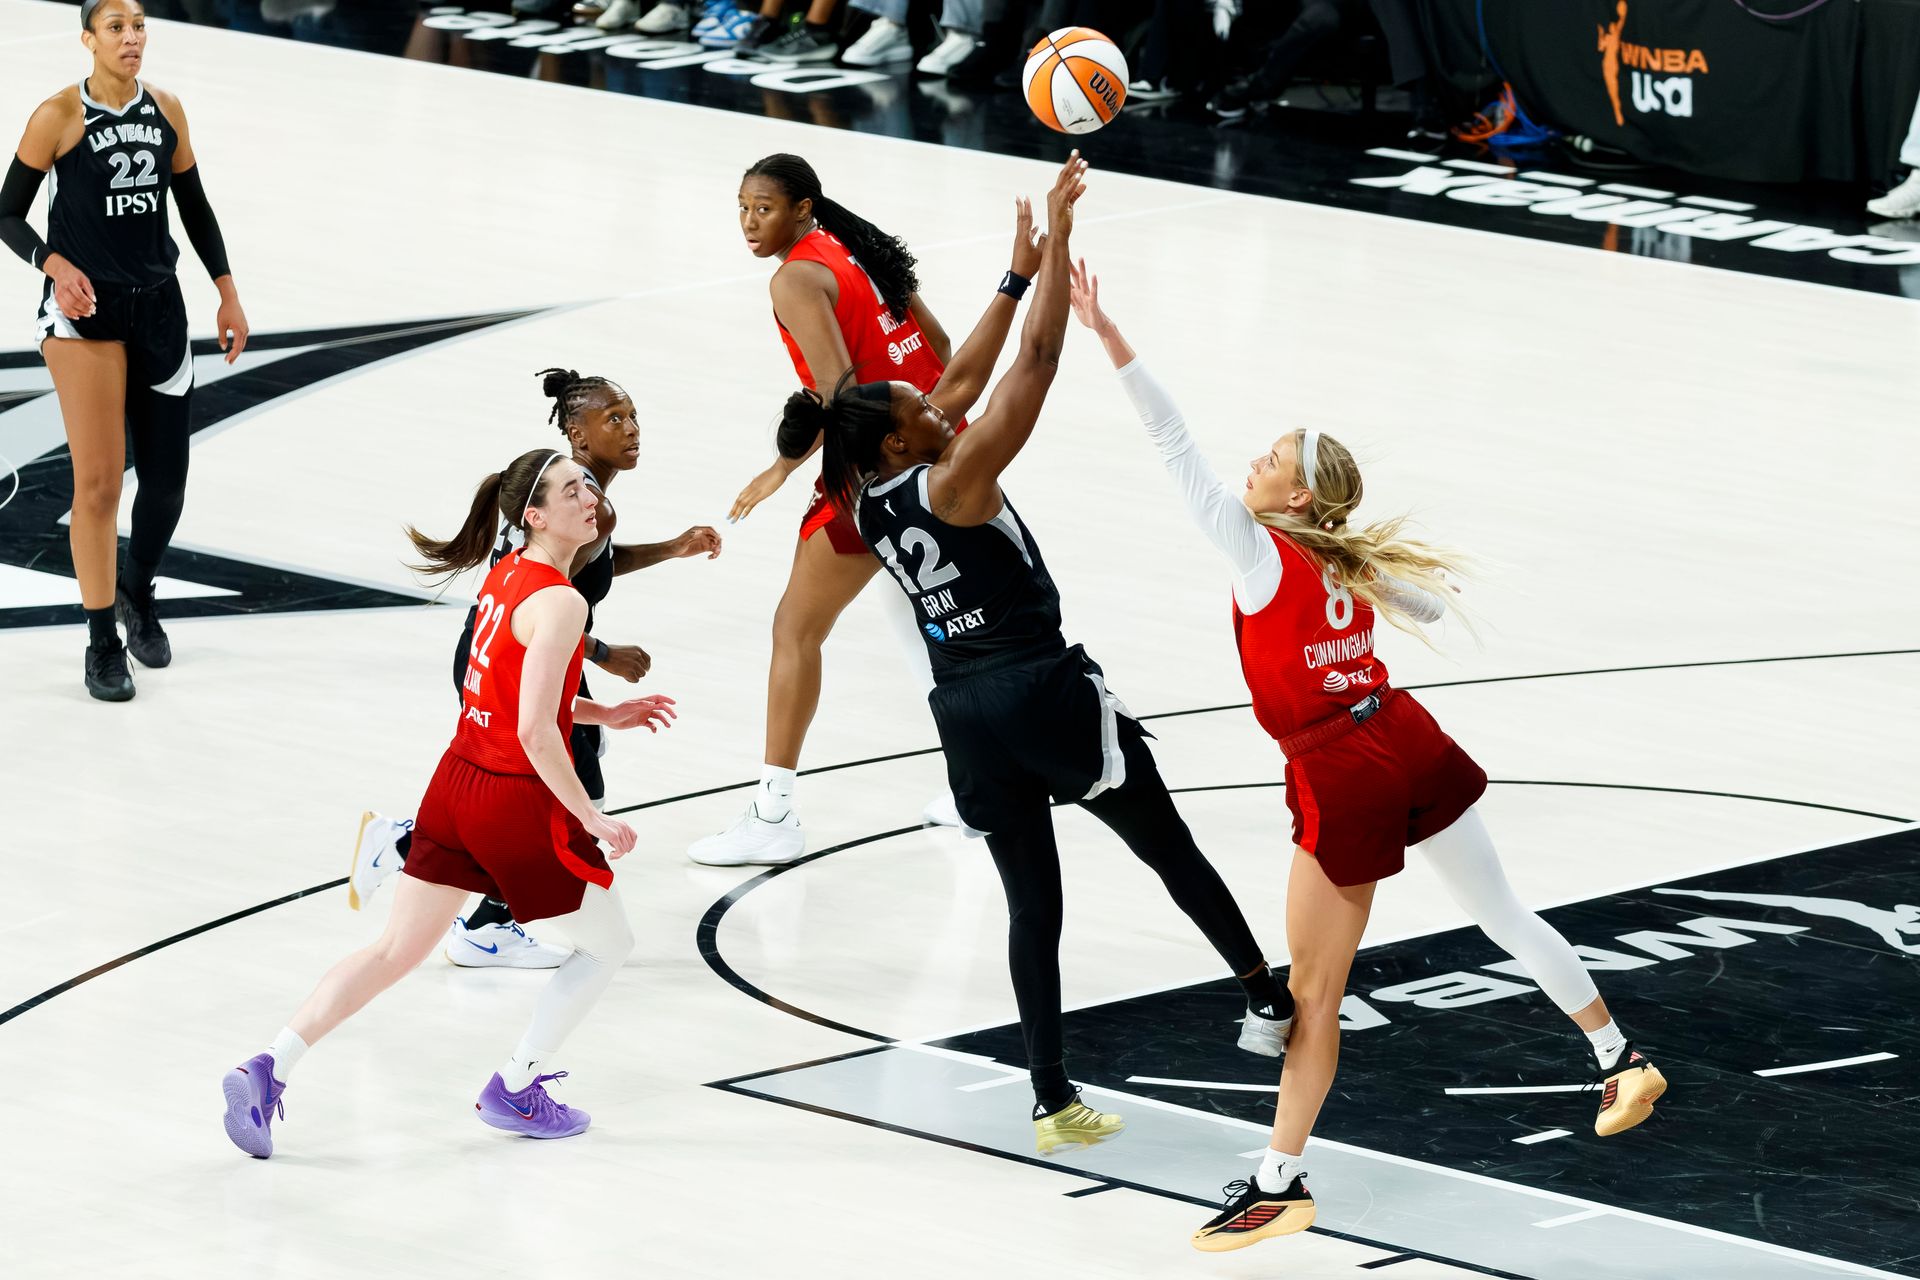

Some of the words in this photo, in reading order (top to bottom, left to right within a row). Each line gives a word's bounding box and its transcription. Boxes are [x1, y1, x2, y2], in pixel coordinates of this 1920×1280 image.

[1621, 41, 1709, 74] WNBA
[88, 127, 118, 153] LAS
[115, 123, 163, 146] VEGAS
[108, 150, 159, 189] 22
[105, 191, 160, 217] IPSY
[877, 311, 907, 336] BOS
[900, 331, 923, 356] AT&T
[875, 526, 961, 594] 12
[921, 588, 959, 619] GRAY
[1322, 562, 1354, 630] 8
[470, 593, 506, 669] 22
[946, 608, 986, 638] AT&T
[1304, 629, 1374, 669] CUNNINGHAM
[1346, 665, 1373, 685] T&T
